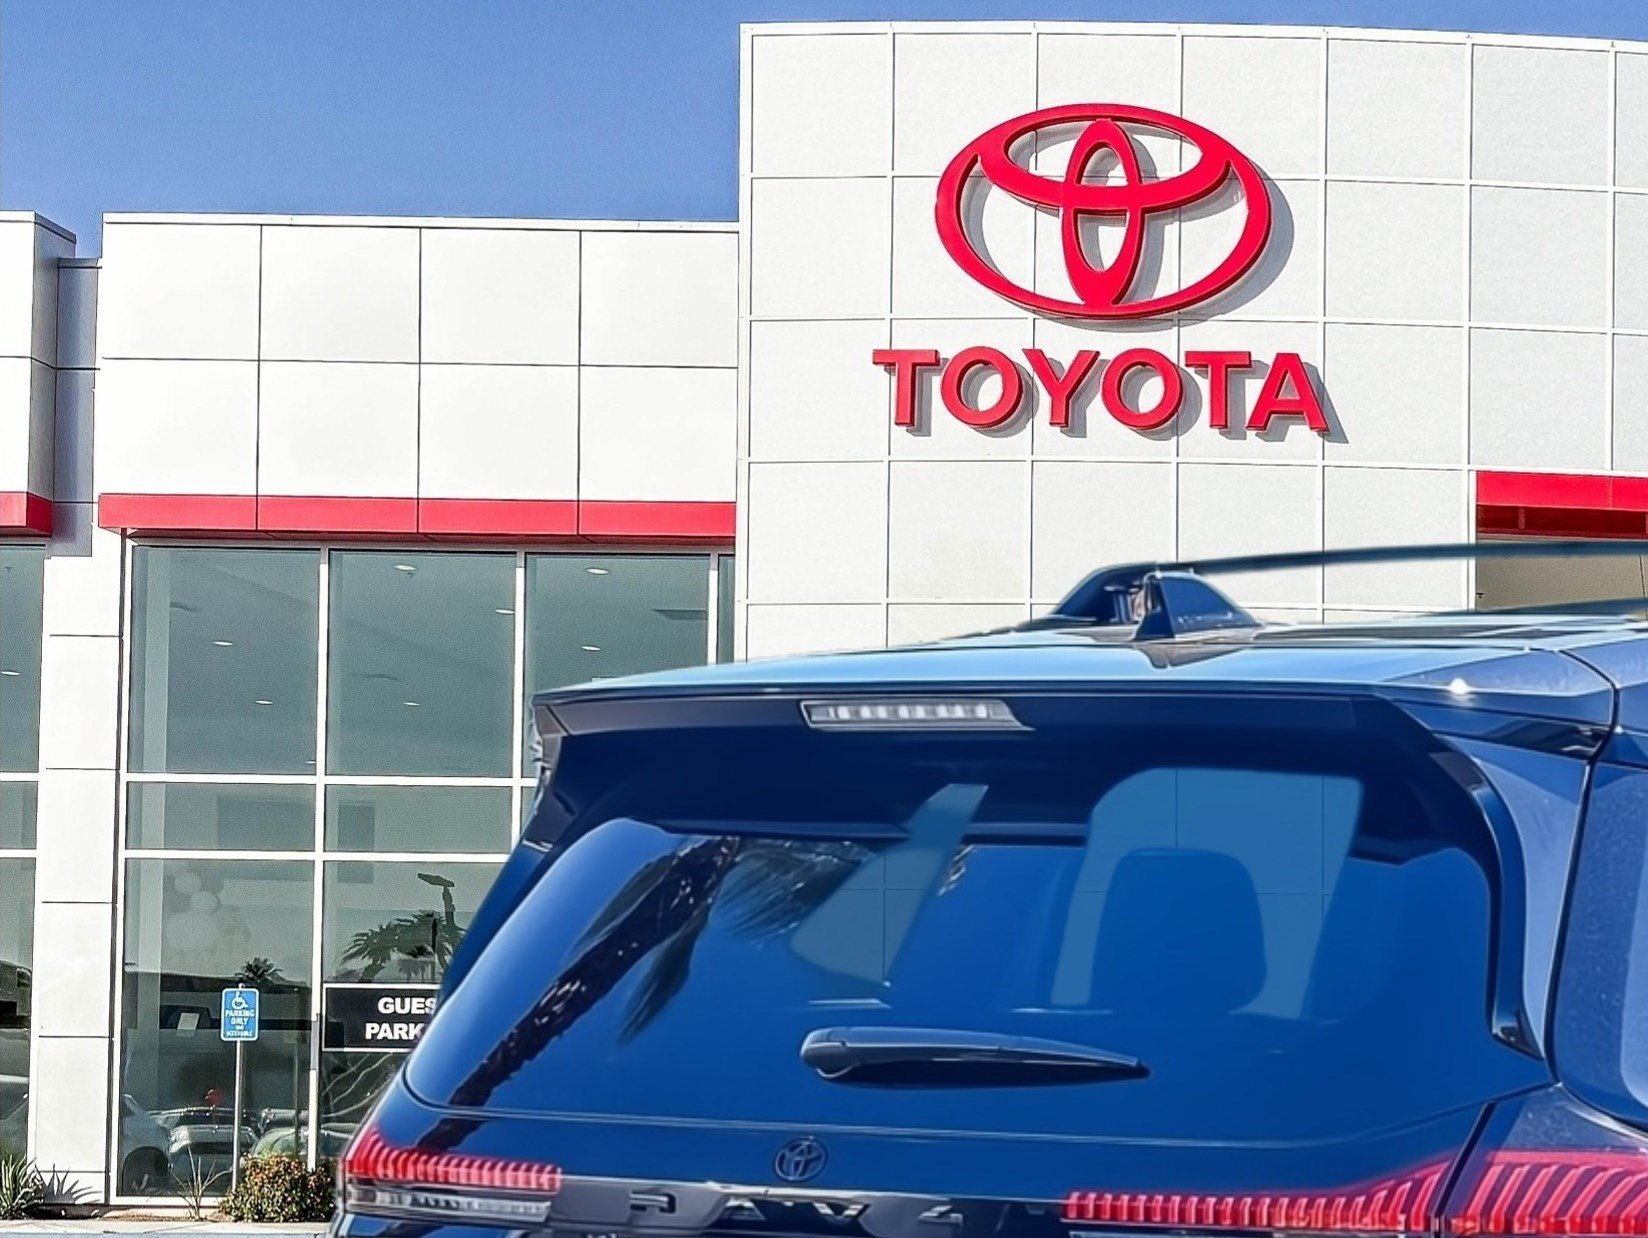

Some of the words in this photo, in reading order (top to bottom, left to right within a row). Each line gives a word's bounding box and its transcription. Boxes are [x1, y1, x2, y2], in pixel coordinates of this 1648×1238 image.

[872, 345, 1330, 434] TOYOTA
[225, 1009, 255, 1018] PARKING
[377, 997, 437, 1015] GUES
[365, 1023, 425, 1040] PARK
